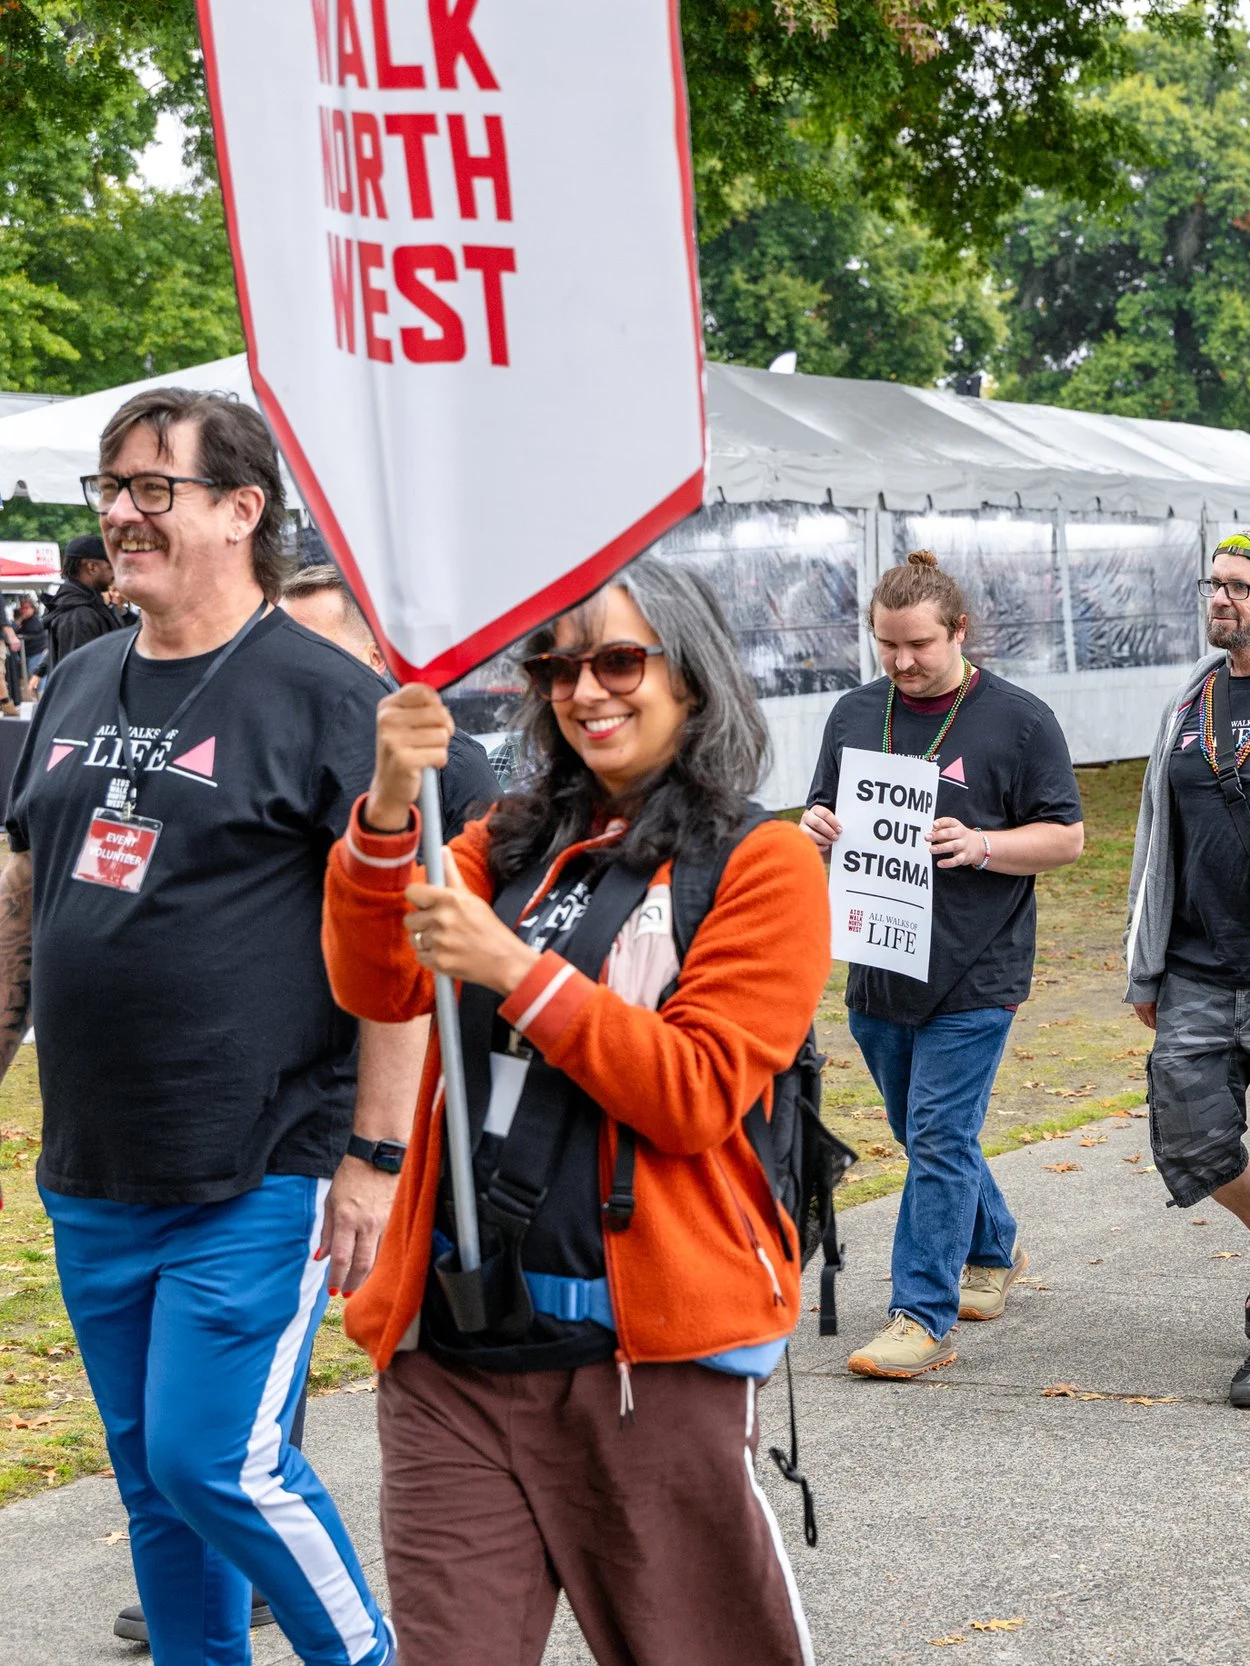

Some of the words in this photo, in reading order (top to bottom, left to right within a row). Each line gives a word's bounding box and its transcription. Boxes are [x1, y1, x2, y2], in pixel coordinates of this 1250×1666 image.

[318, 104, 513, 222] NORTH
[326, 231, 517, 368] WEST
[96, 725, 118, 736] ALL
[128, 726, 162, 739] ALKS
[855, 778, 933, 815] STOMP
[105, 831, 138, 848] EVENT
[873, 818, 921, 848] OUT
[843, 849, 929, 891] STIGMA
[866, 921, 917, 955] LIFE
[869, 912, 885, 922] ALL
[886, 915, 910, 929] WALKS
[910, 922, 918, 931] OF
